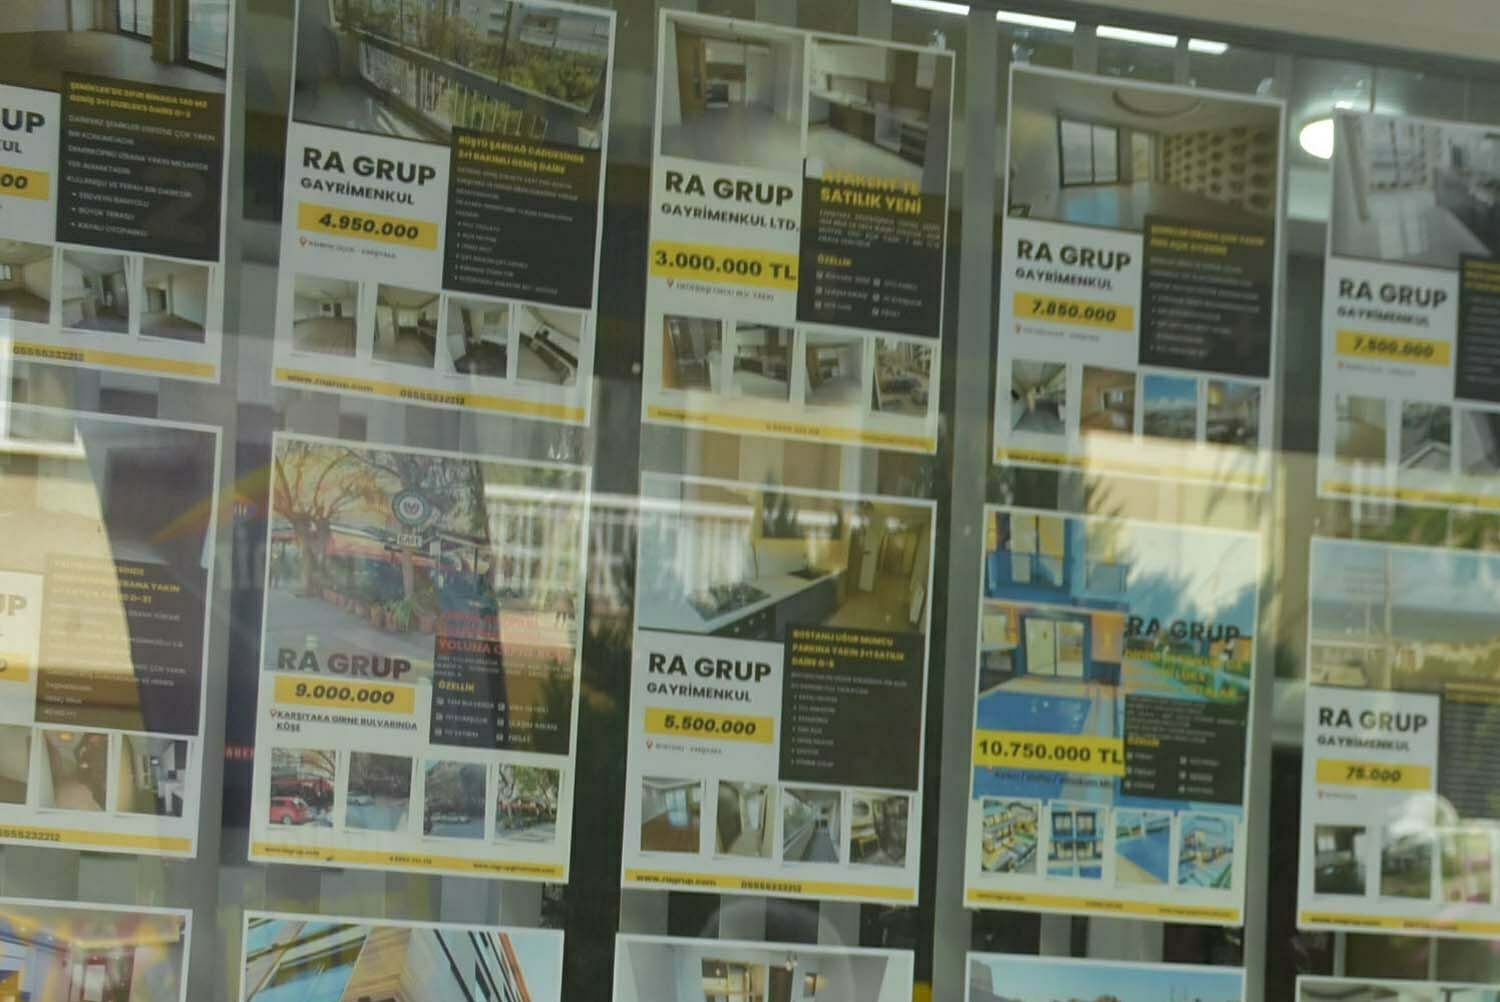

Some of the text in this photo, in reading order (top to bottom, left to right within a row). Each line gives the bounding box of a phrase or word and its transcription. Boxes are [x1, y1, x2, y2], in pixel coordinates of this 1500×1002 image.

[302, 147, 436, 186] RA GRUP
[300, 176, 414, 205] GAYRİMENKUL
[666, 170, 793, 206] RA GRUP
[318, 213, 418, 240] 4.950.000
[661, 203, 768, 228] GAYRİMENKUL
[655, 250, 762, 277] 3.000.000
[1017, 238, 1130, 272] RA GRUP
[1340, 278, 1447, 309] RA GRUP
[1124, 616, 1240, 643] RA GRUP
[278, 648, 320, 672] RA
[327, 653, 411, 679] GRUP
[648, 652, 771, 682] RA GRUP
[295, 682, 394, 704] 9.000.000
[646, 681, 752, 703] GAYRİMENKUL
[664, 714, 756, 735] 5.500.000
[1318, 706, 1428, 734] RA GRUP
[979, 740, 1122, 764] 10.750.000 TL
